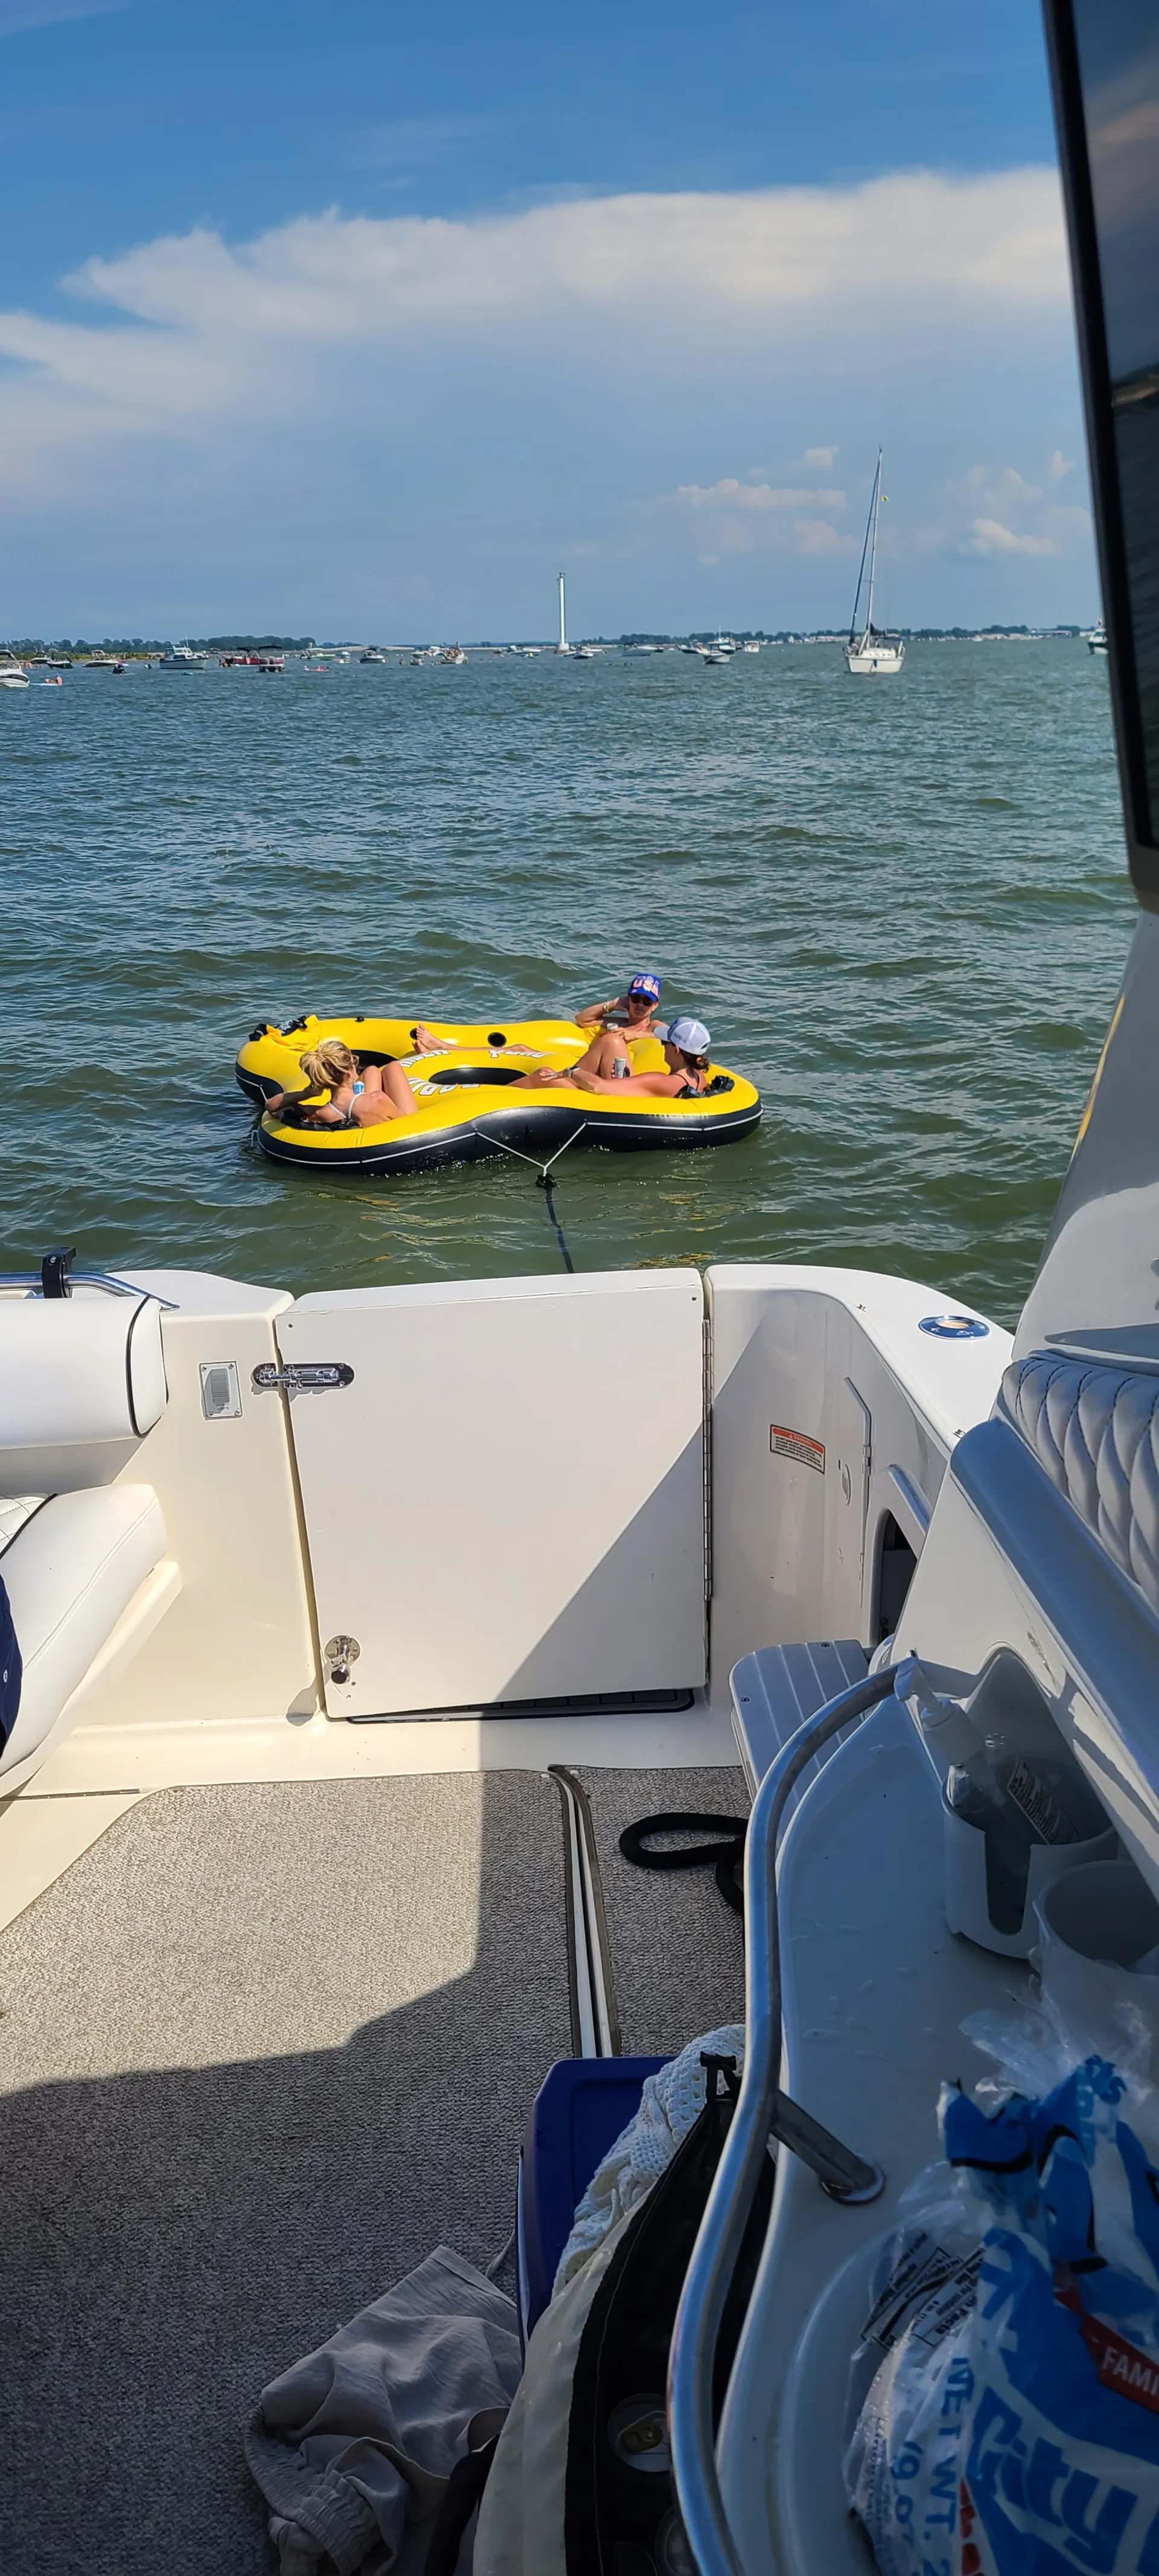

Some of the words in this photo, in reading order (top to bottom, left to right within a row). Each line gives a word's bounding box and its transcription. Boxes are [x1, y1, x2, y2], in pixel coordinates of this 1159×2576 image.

[633, 976, 659, 997] USA
[935, 2308, 969, 2335] Facts
[940, 2357, 974, 2440] NET
[924, 2455, 957, 2540] WT.
[968, 2386, 1137, 2575] City
